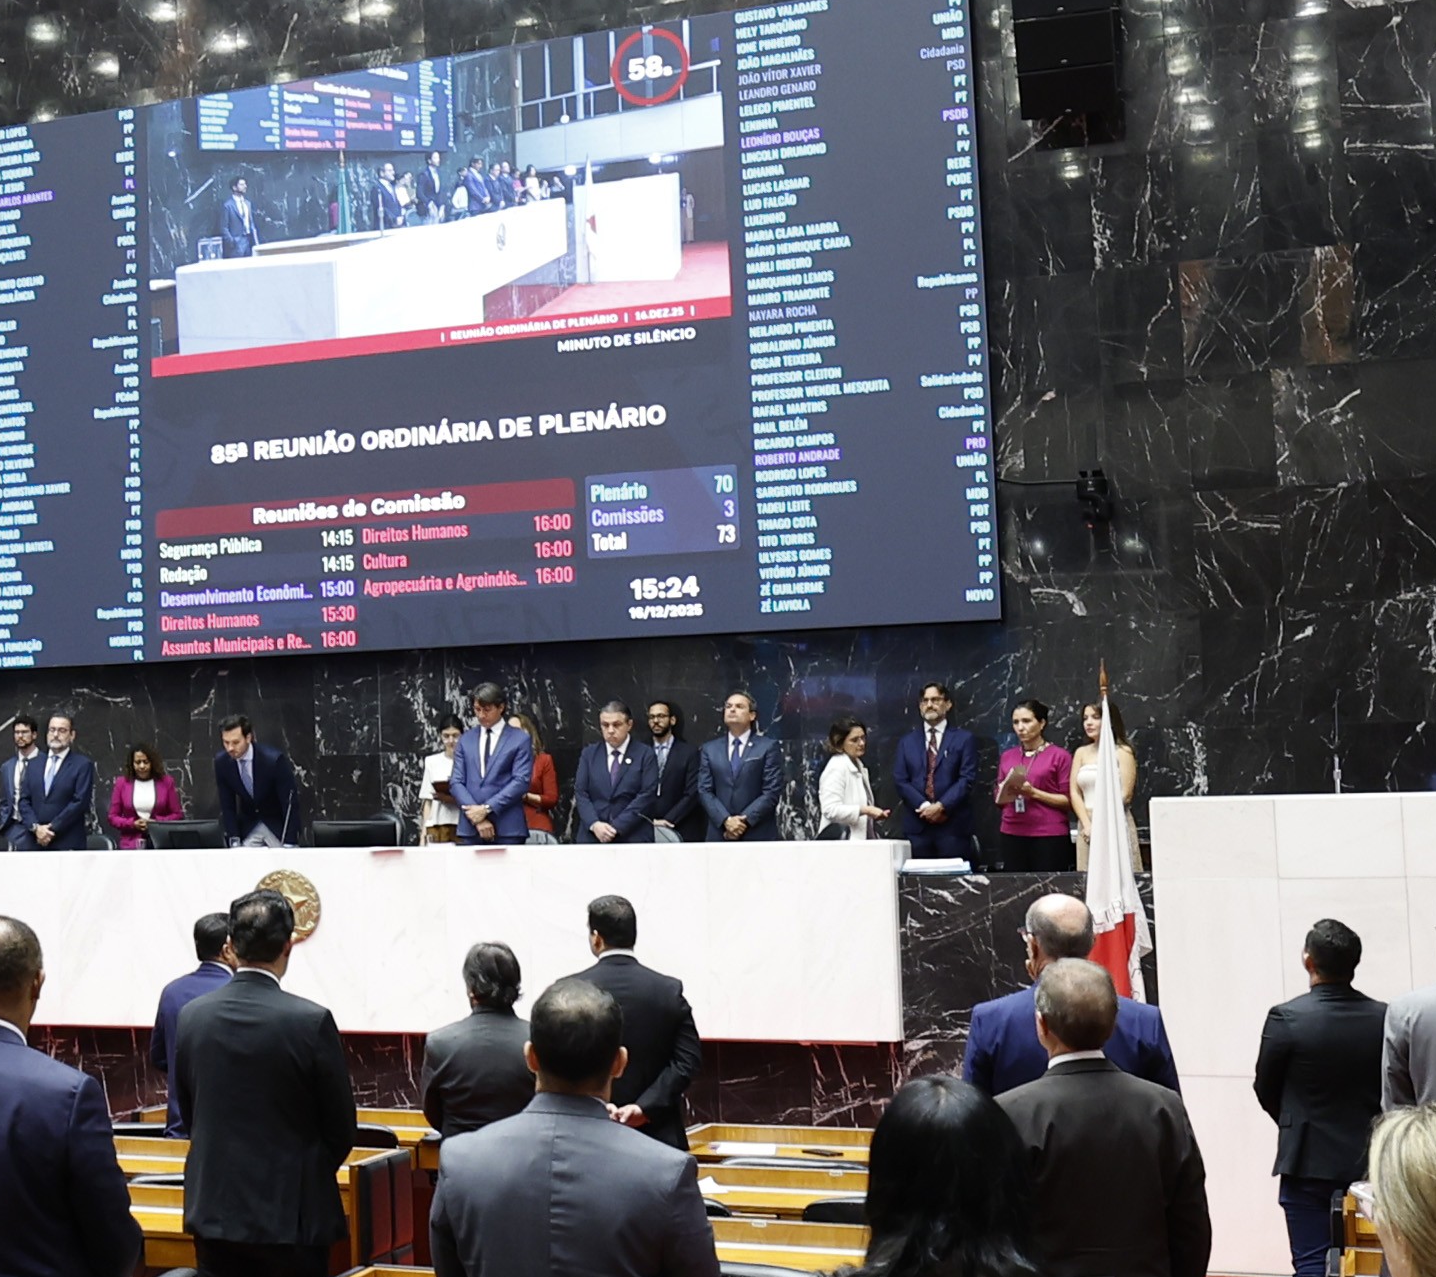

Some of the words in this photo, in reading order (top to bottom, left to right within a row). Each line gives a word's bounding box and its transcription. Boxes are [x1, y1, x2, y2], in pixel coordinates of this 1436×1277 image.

[738, 70, 760, 85] JOÃO
[762, 66, 788, 82] VÍTOR
[790, 63, 820, 78] XAVIER
[920, 42, 964, 59] Cidadania
[739, 85, 778, 100] LEANDRO
[780, 80, 816, 95] GENARO
[947, 58, 965, 71] PSD
[741, 130, 781, 148] LEONÍDIO
[783, 127, 819, 144] BOUÇAS
[943, 107, 968, 121] PSDB
[22, 190, 52, 204] ARANTES
[749, 308, 783, 321] NAYARA
[785, 304, 816, 317] ROCHA
[965, 287, 978, 299] PP
[450, 325, 493, 340] REUNIÃO
[495, 319, 550, 335] ORDINÁRIA
[552, 318, 566, 329] DE
[567, 312, 618, 327] PLENÁRIO
[557, 335, 611, 352] MINUTO
[613, 333, 631, 346] DE
[633, 325, 696, 344] SILÊNCIO
[253, 427, 354, 460] REUNIÃO
[361, 413, 492, 451] ORDINÁRIA
[498, 416, 531, 438] DE
[538, 397, 666, 435] PLENÁRIO
[755, 452, 796, 465] ROBERTO
[798, 448, 839, 462] ANDRADE
[966, 437, 985, 449] PRD
[591, 480, 646, 502] Plenário
[714, 474, 733, 493] 70
[253, 500, 337, 524] Reuniões
[342, 497, 366, 517] de
[371, 490, 465, 515] Comissão
[591, 504, 663, 526] Comissões
[724, 499, 734, 517] 3
[362, 525, 409, 543] Direitos
[411, 521, 467, 540] Humanos
[534, 513, 570, 531] 16:00
[591, 531, 626, 551] Total
[716, 524, 735, 543] 73
[159, 538, 217, 562] Segurança
[219, 535, 261, 554] Pública
[321, 528, 353, 547] 14:15
[363, 551, 406, 569] Cultura
[535, 540, 571, 558] 16:00
[160, 564, 207, 586] Redação
[322, 554, 354, 572] 14:15
[363, 574, 442, 598] Agropecuária
[445, 577, 453, 589] e
[535, 565, 572, 584] 16:00
[161, 586, 254, 607] Desenvolvimento
[320, 579, 354, 597] 15:00
[630, 575, 699, 600] 15:24
[161, 613, 204, 631] Direitos
[207, 610, 259, 628] Humanos
[322, 605, 354, 622] 15:30
[161, 638, 211, 655] Assuntos
[213, 634, 274, 656] Municipais
[276, 638, 284, 649] e
[321, 630, 355, 647] 16:00
